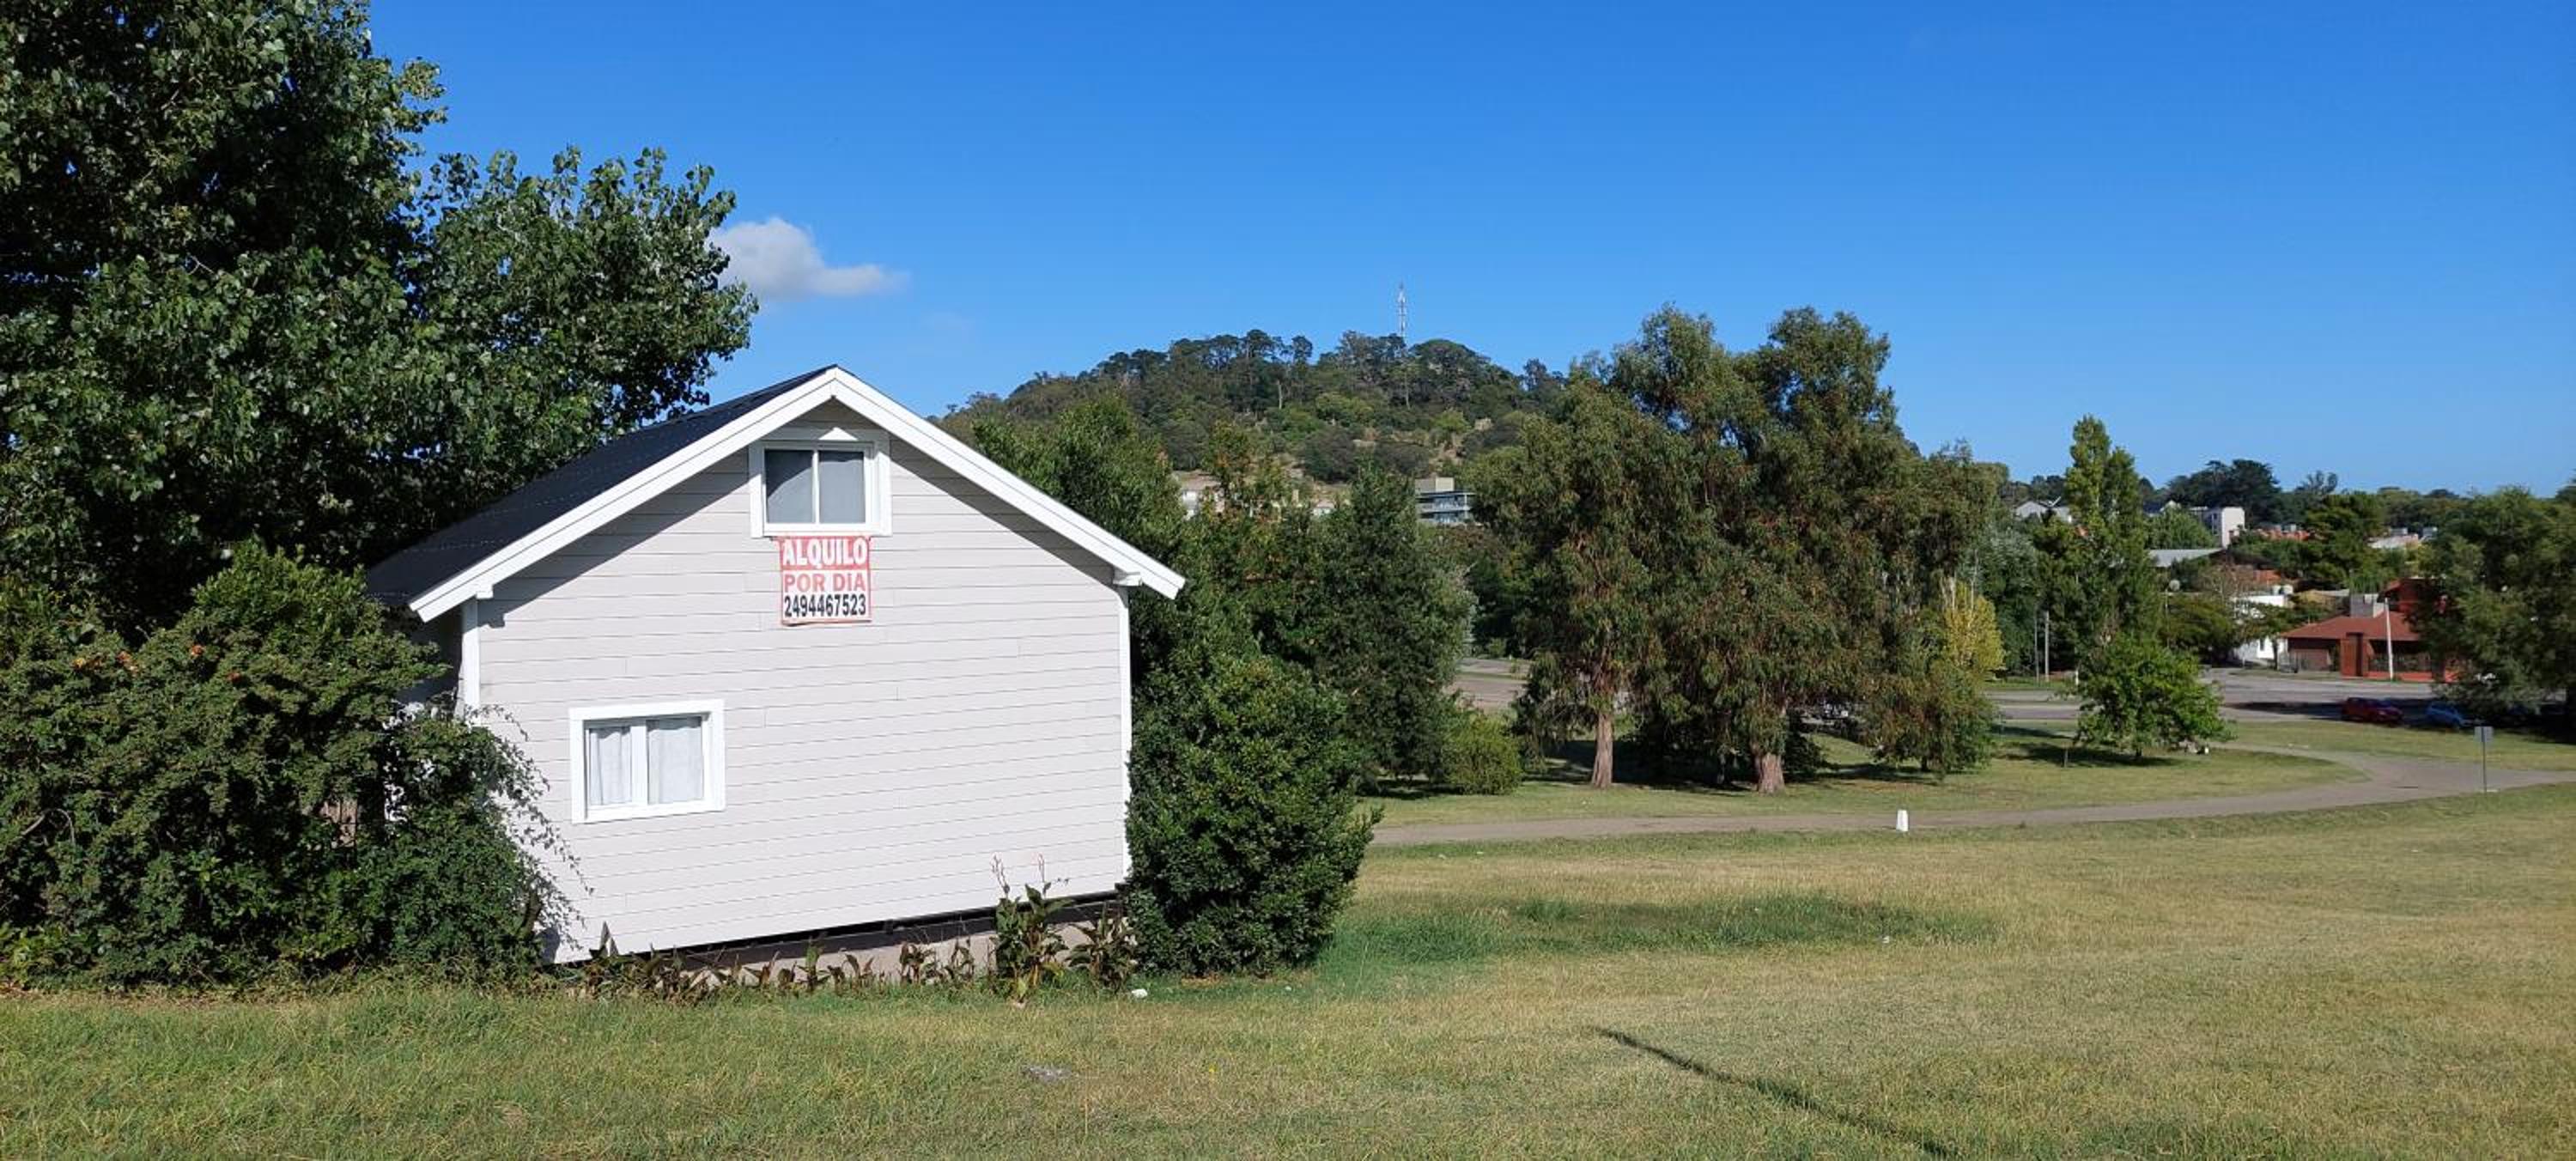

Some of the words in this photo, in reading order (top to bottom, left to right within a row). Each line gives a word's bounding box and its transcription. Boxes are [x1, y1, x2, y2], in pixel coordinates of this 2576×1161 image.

[782, 538, 867, 568] ALQUILO
[784, 573, 825, 593] POR
[833, 573, 866, 592] DIA
[784, 593, 866, 617] 2494467523
